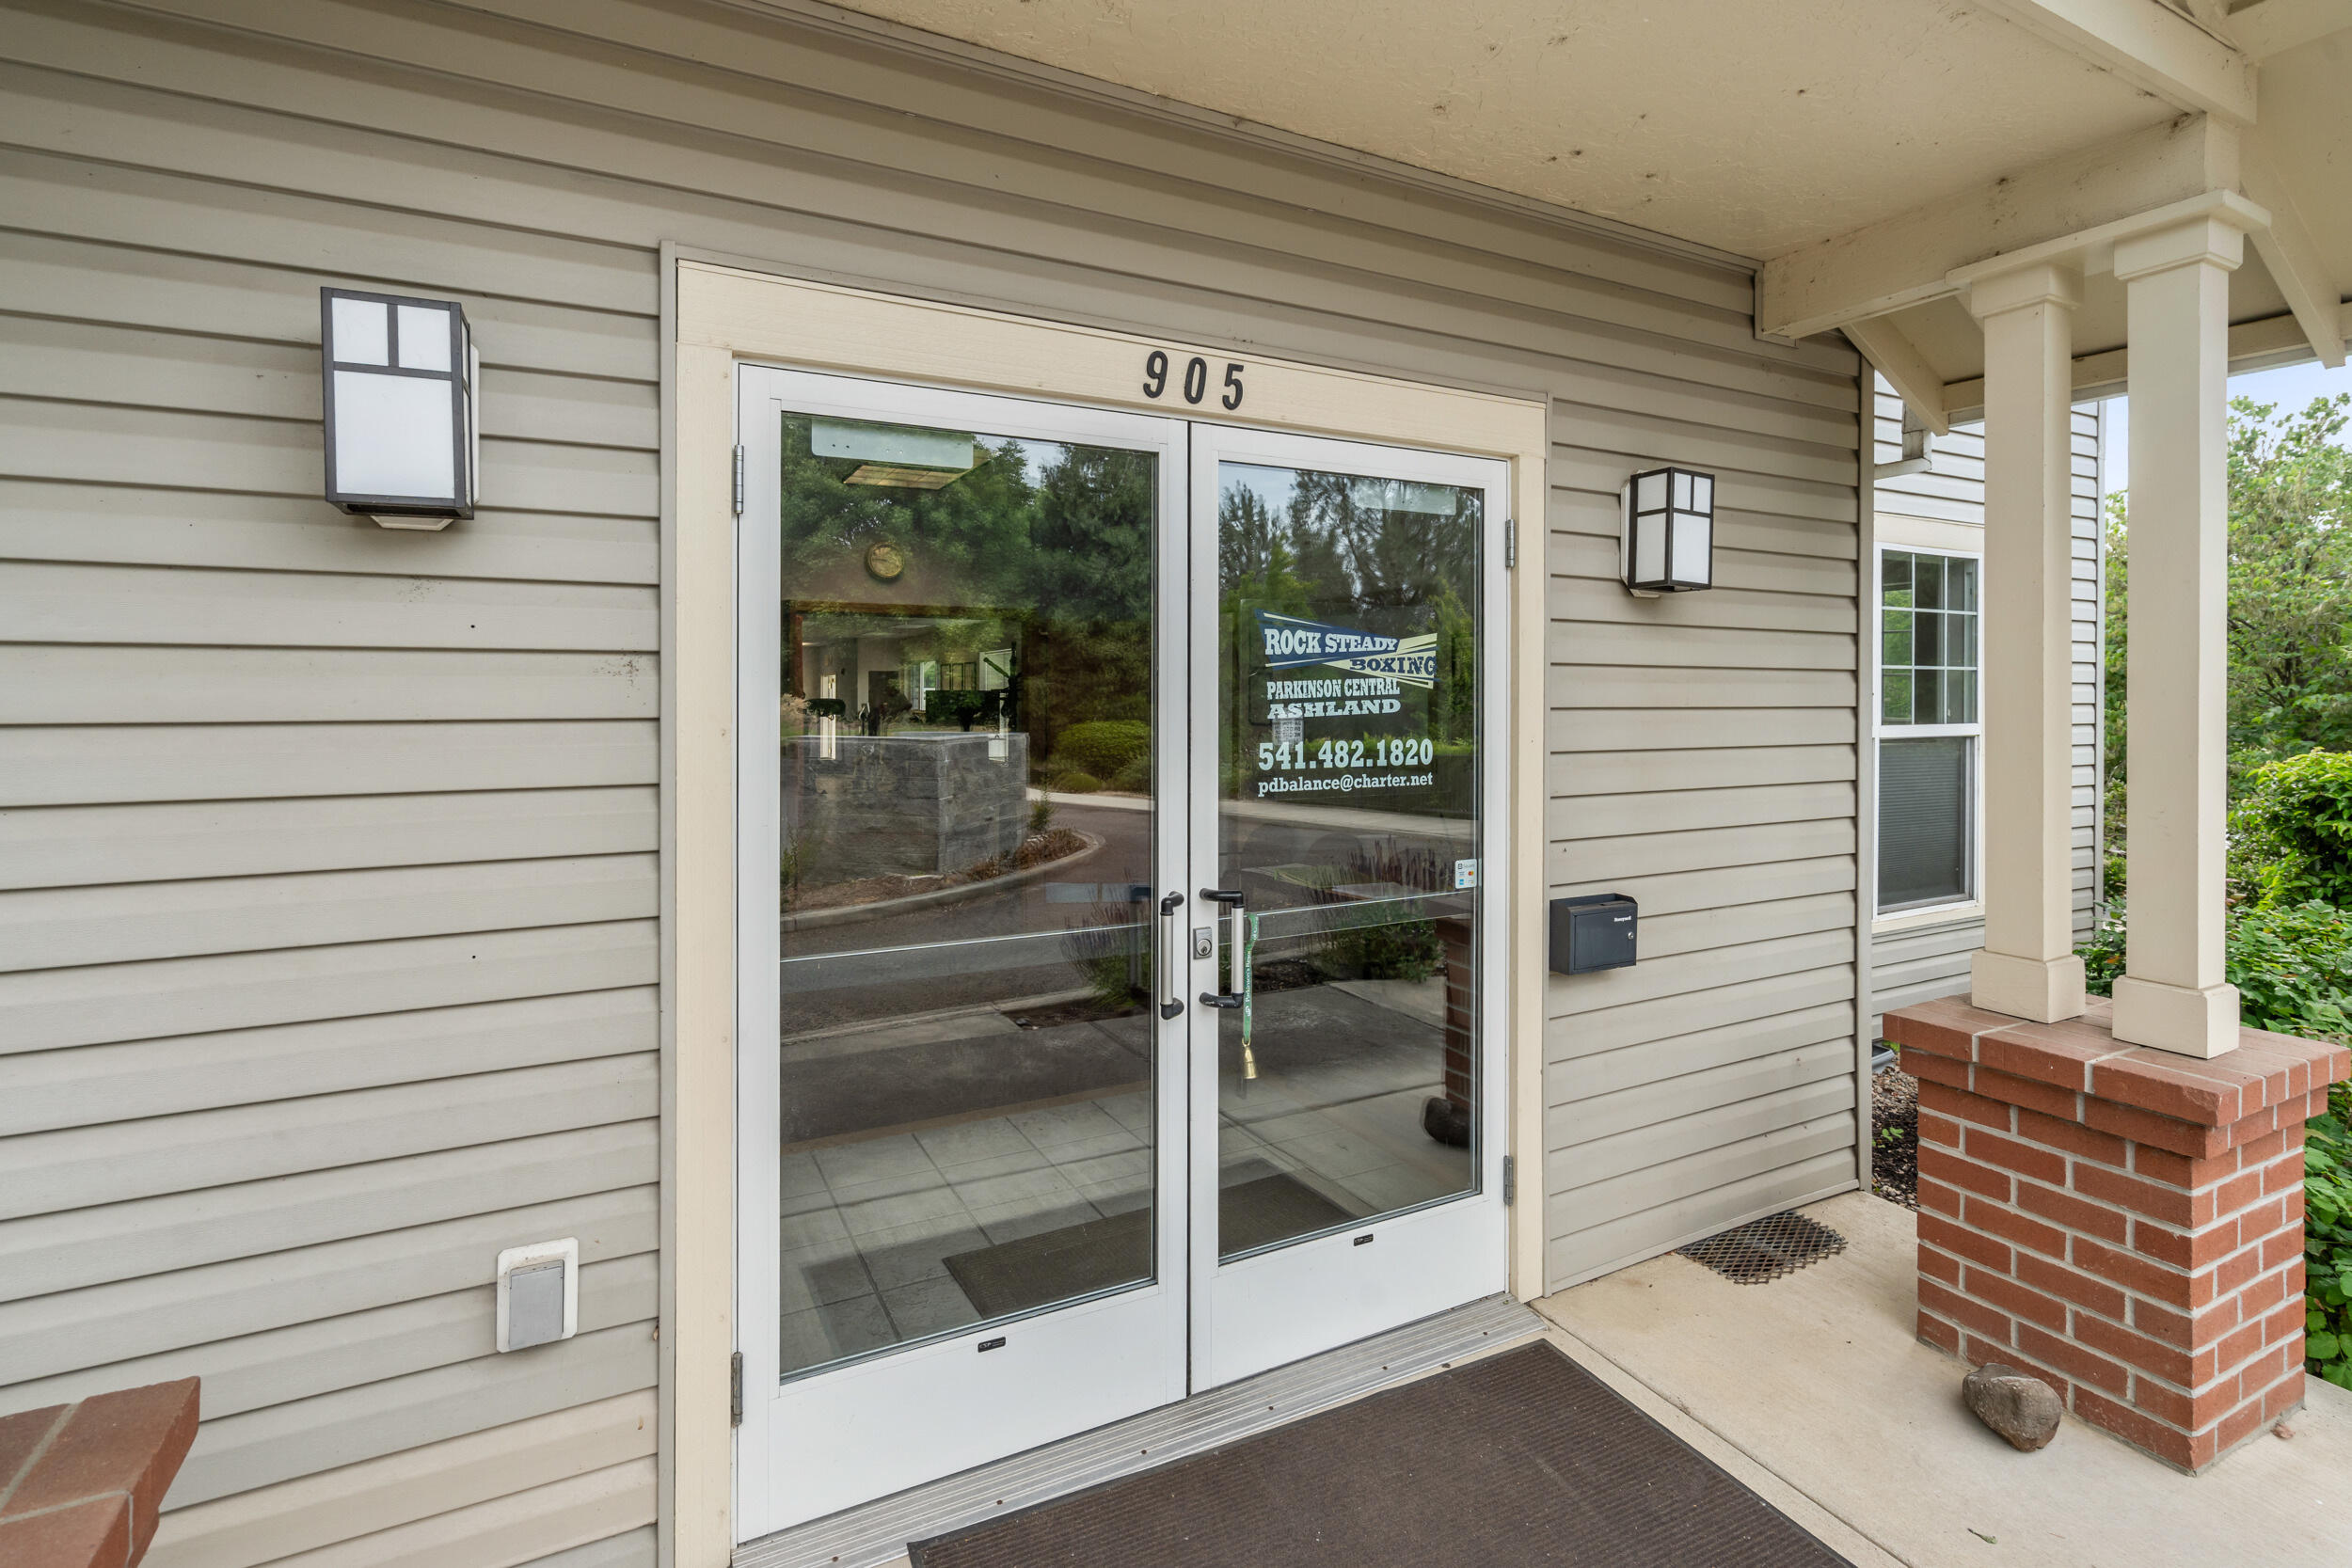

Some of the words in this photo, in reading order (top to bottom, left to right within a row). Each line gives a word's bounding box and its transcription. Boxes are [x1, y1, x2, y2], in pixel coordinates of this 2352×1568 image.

[1143, 351, 1244, 410] 905
[1264, 628, 1321, 655] ROCK
[1325, 633, 1399, 653] STEADY
[1349, 656, 1438, 675] BOXING
[1267, 679, 1342, 700] PARKINSON
[1344, 678, 1400, 696] CENTRAL
[1267, 699, 1401, 720] ASHLAND
[1258, 738, 1434, 770] 541.482.1820
[1258, 772, 1433, 798] pdbalance@charter.net
